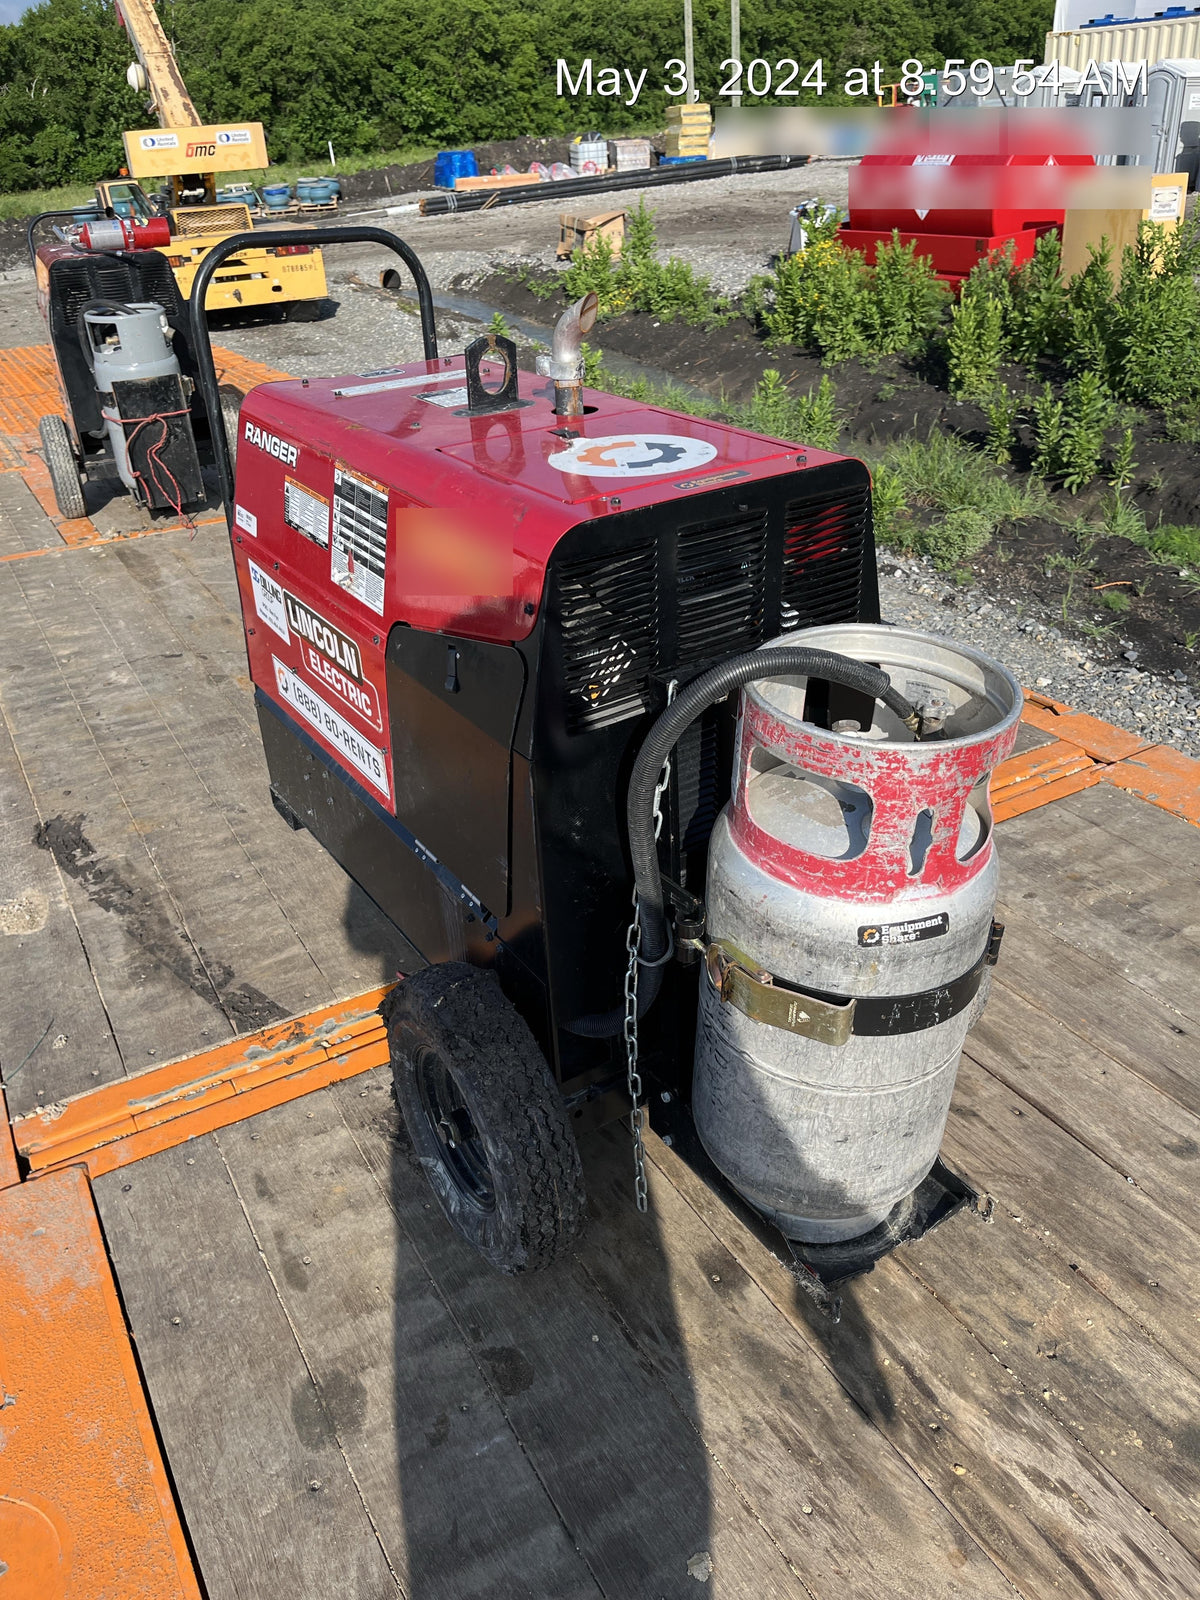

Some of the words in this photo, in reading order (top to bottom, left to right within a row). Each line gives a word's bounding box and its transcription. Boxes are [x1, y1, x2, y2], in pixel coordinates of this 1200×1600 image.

[244, 420, 298, 469] RANGER
[287, 598, 359, 679] LINCOLN
[308, 647, 373, 717] ELECTRIC
[292, 682, 322, 725] (888)
[323, 711, 381, 778] 80-RENTS
